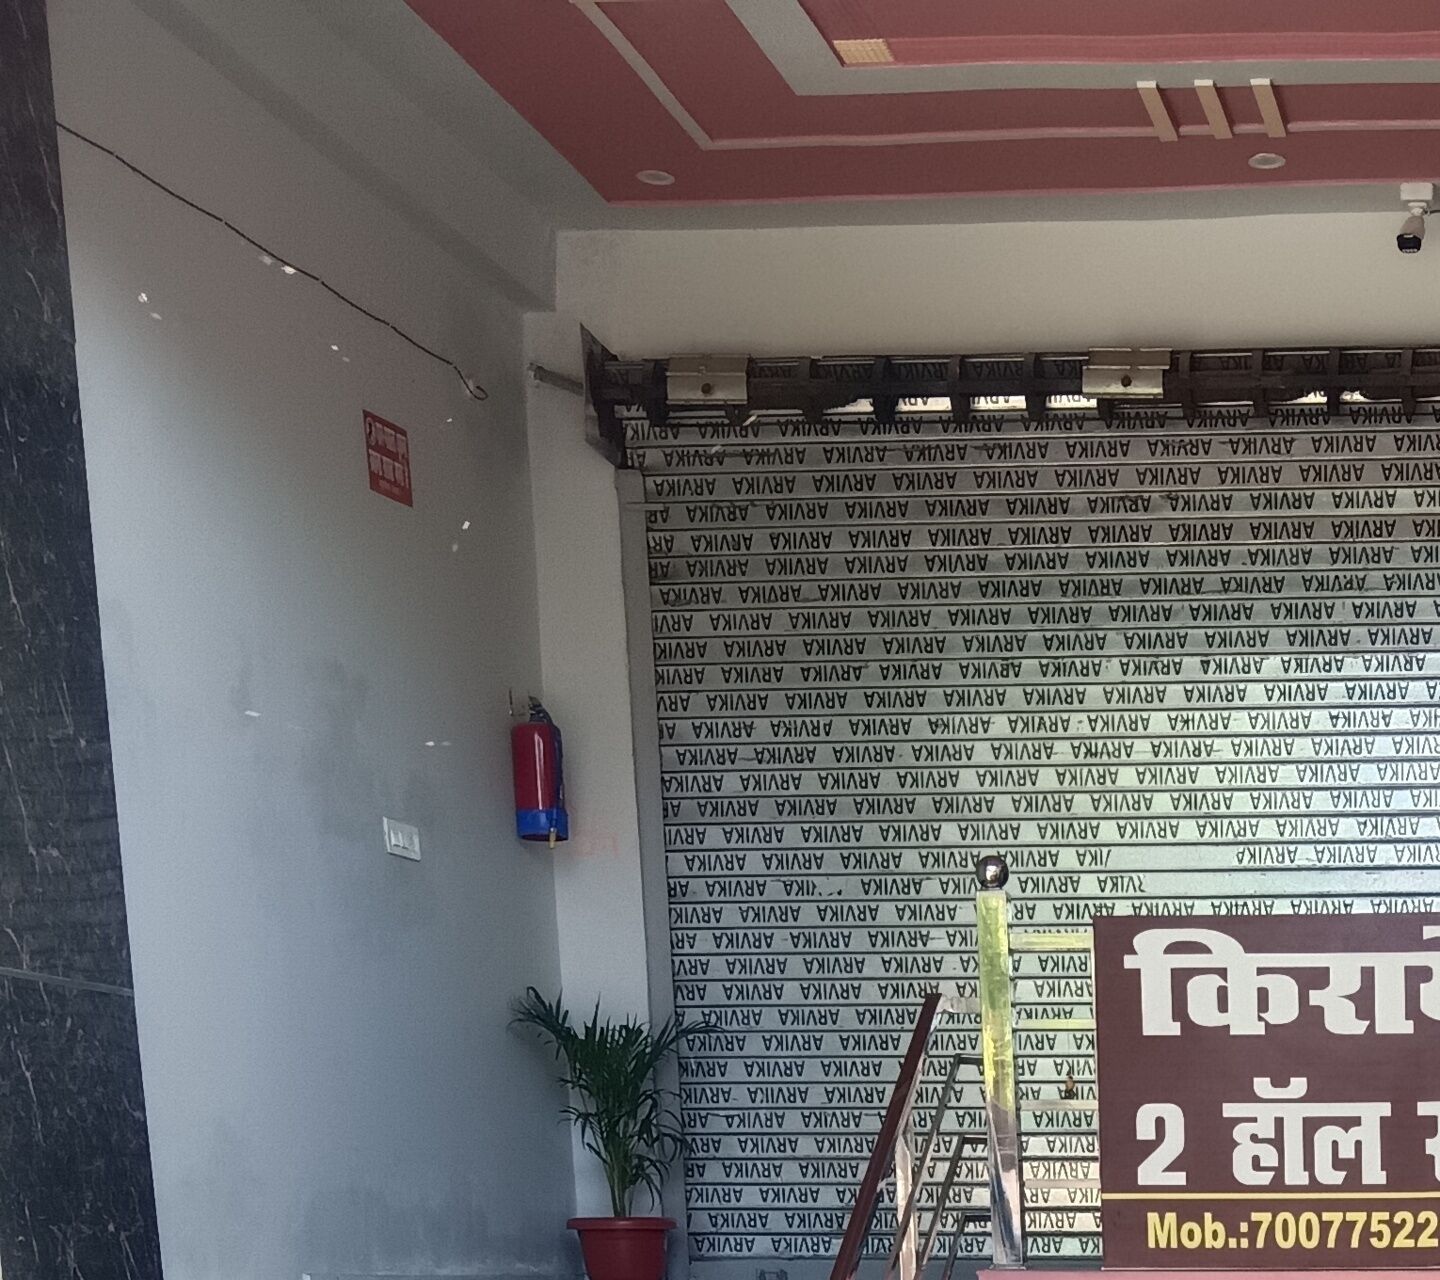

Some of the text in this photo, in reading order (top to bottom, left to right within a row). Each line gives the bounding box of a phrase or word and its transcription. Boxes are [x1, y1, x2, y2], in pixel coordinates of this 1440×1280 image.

[984, 441, 1052, 461] ARVIKA
[812, 474, 878, 493] ARVIKA
[1054, 468, 1122, 488] ARVIKA
[1298, 464, 1366, 484] ARVIKA
[686, 504, 750, 523] ARVIKA
[926, 498, 990, 517] ARVIKA
[1168, 493, 1236, 513] ARVIKA
[770, 531, 834, 550] ARVIKA
[1008, 526, 1074, 545] ARVIKA
[1250, 521, 1316, 540] ARVIKA
[844, 555, 910, 574] ARVIKA
[1086, 550, 1150, 569] ARVIKA
[1330, 546, 1394, 565] ARVIKA
[660, 587, 724, 606] ARVIKA
[898, 581, 962, 600] ARVIKA
[1140, 577, 1204, 596] ARVIKA
[788, 611, 854, 630] ARVIKA
[1028, 606, 1094, 625] ARVIKA
[1270, 601, 1338, 621] ARVIKA
[882, 636, 948, 655] ARVIKA
[1122, 631, 1190, 651] ARVIKA
[1368, 627, 1436, 647] ARVIKA
[720, 665, 786, 684] ARVIKA
[958, 661, 1024, 680] ARVIKA
[1200, 656, 1264, 675] ARVIKA
[784, 683, 1330, 710] ARVIKA ARVIKA ARVIKA
[770, 715, 1072, 738] ARVIKA ARVIKA
[676, 740, 1216, 766] ARVIKA ARVIKA ARVIKA
[818, 764, 1362, 791] ARVIKA ARVIKA ARVIKA
[698, 799, 760, 817] ARVIKA
[932, 796, 996, 815] ARVIKA
[1170, 792, 1234, 811] ARVIKA
[802, 822, 1102, 843] ARVIKA ARVIKA
[686, 852, 902, 872] ARVIKA ARVIKA ARVIKA
[706, 880, 768, 898] ARVIKA
[862, 875, 1082, 896] ARVIKA ARVIKA
[740, 903, 960, 923] ARVIKA ARVIKA ARVIKA
[712, 930, 930, 949] ARVIKA ARVIKA ARVIKA
[724, 955, 946, 976] ARVIKA ARVIKA ARVIKA
[722, 982, 862, 1001] ARVIKA ARVIKA
[778, 1008, 918, 1026] ARVIKA ARVIKA
[686, 1033, 902, 1052] ARVIKA ARVIKA ARVIKA
[744, 1060, 884, 1078] ARVIKA ARVIKA
[824, 1086, 886, 1104] ARVIKA
[724, 1111, 864, 1129] ARVIKA ARVIKA
[1032, 1110, 1094, 1128] ARVIKA
[1135, 1102, 1188, 1187] 2
[1222, 1077, 1392, 1186] हॉल
[738, 1136, 876, 1154] ARVIKA ARVIKA
[722, 1161, 860, 1179] ARVIKA ARVIKA
[682, 1186, 820, 1204] ARVIKA ARVIKA
[708, 1211, 846, 1229] ARVIKA ARVIKA
[694, 1235, 756, 1253] ARVIKA
